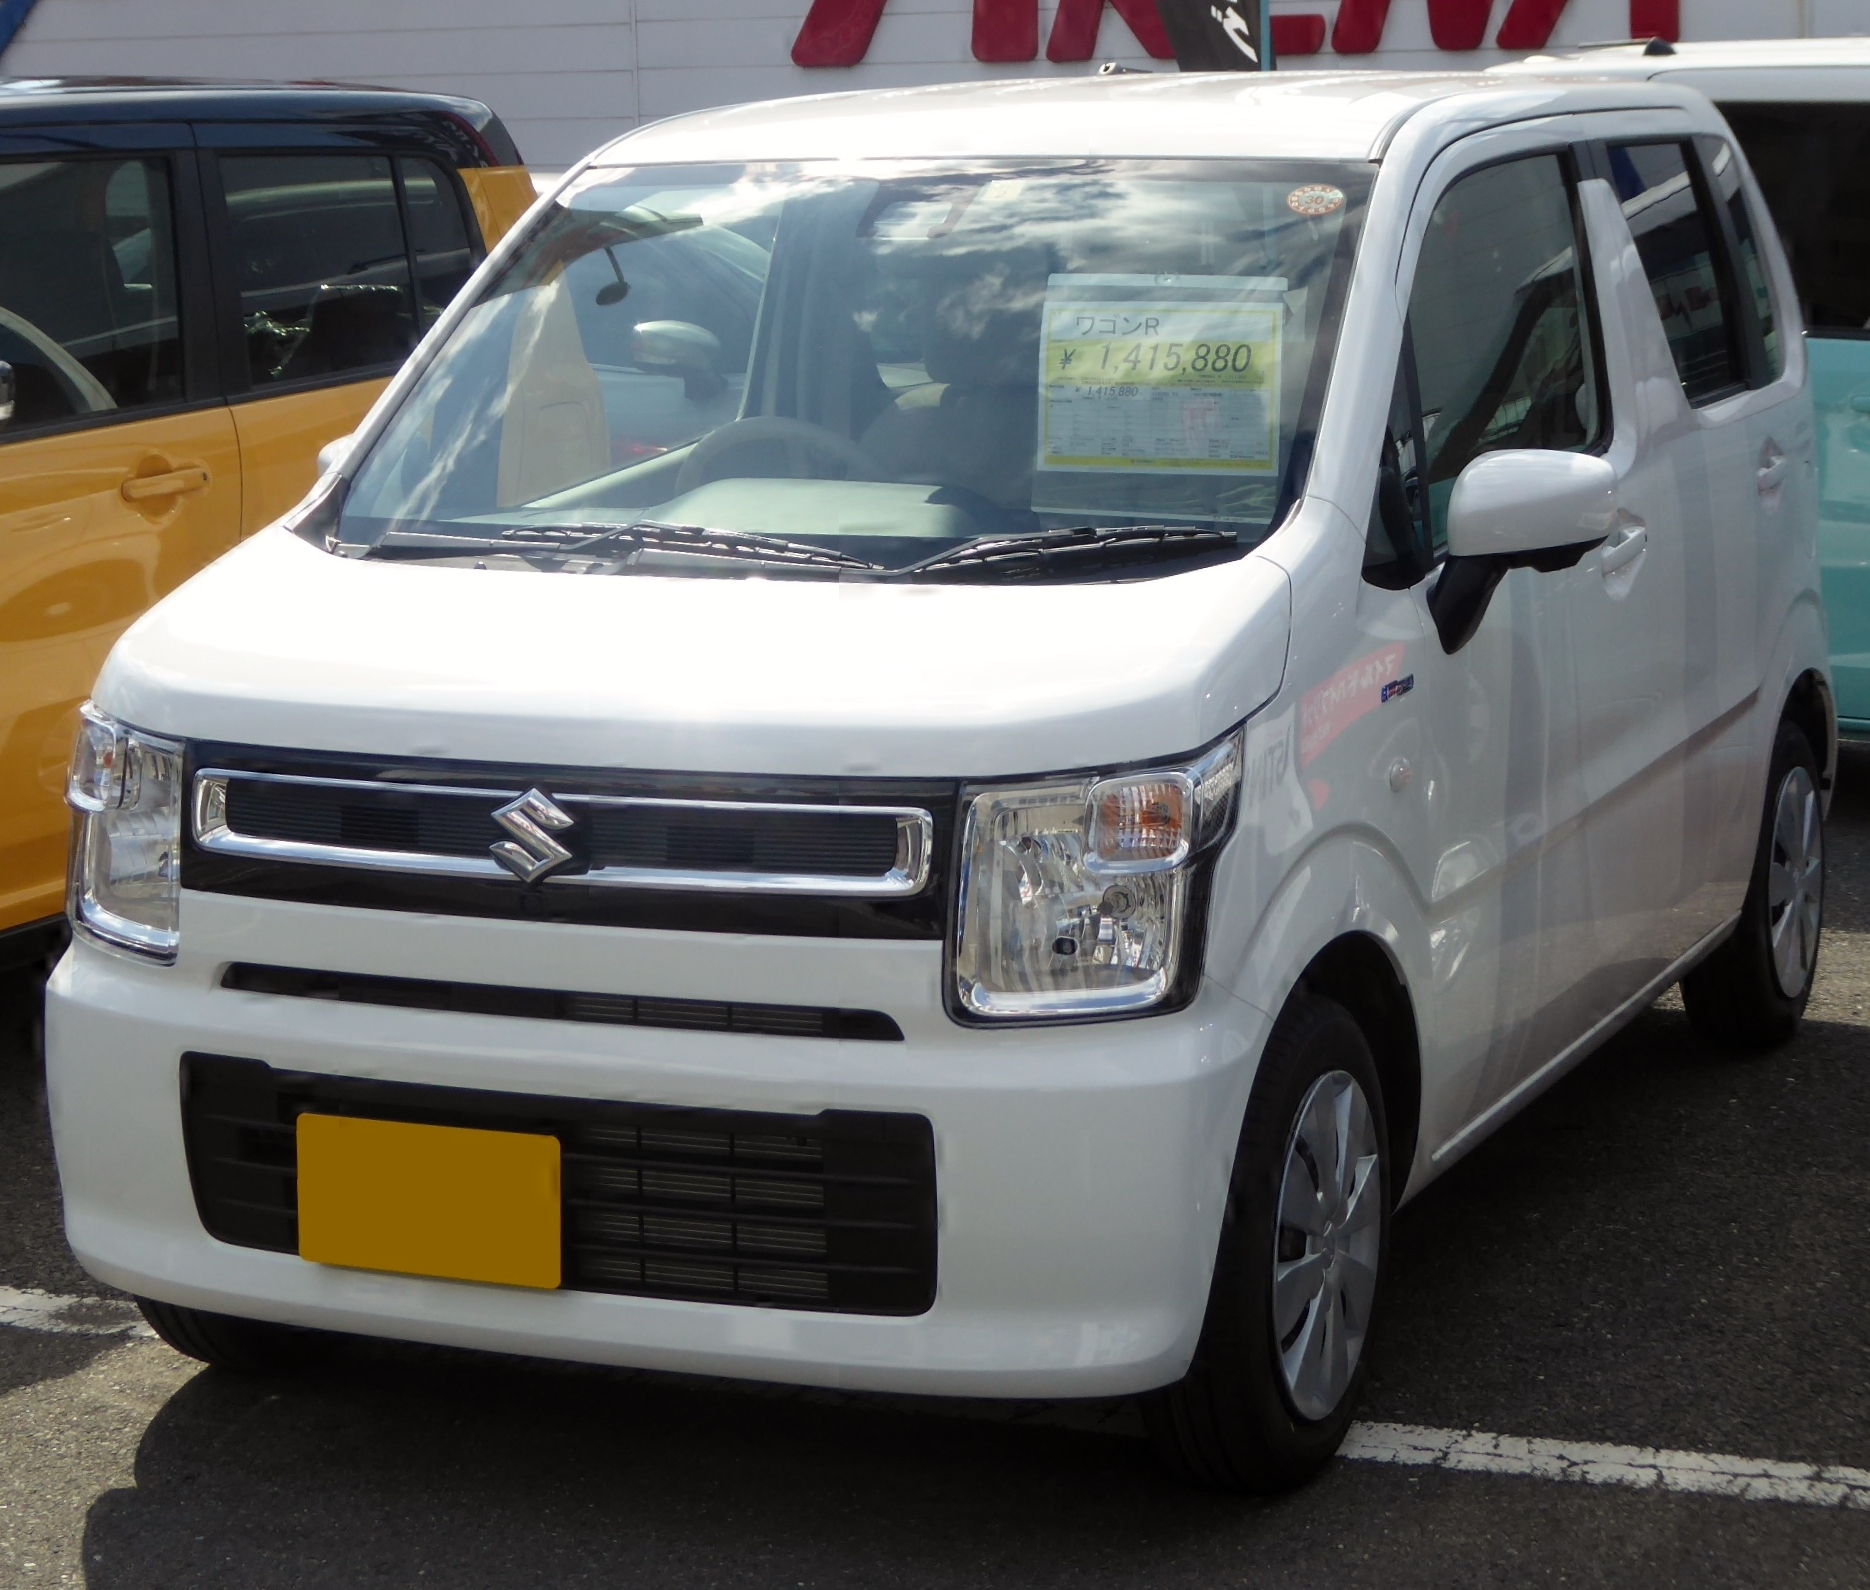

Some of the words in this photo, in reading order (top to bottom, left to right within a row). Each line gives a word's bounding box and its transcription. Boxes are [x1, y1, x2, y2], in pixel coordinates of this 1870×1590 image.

[1305, 195, 1324, 205] 30
[1076, 314, 1160, 336] ワゴンR
[1059, 348, 1076, 370] ¥
[1100, 342, 1251, 376] 1,415,880
